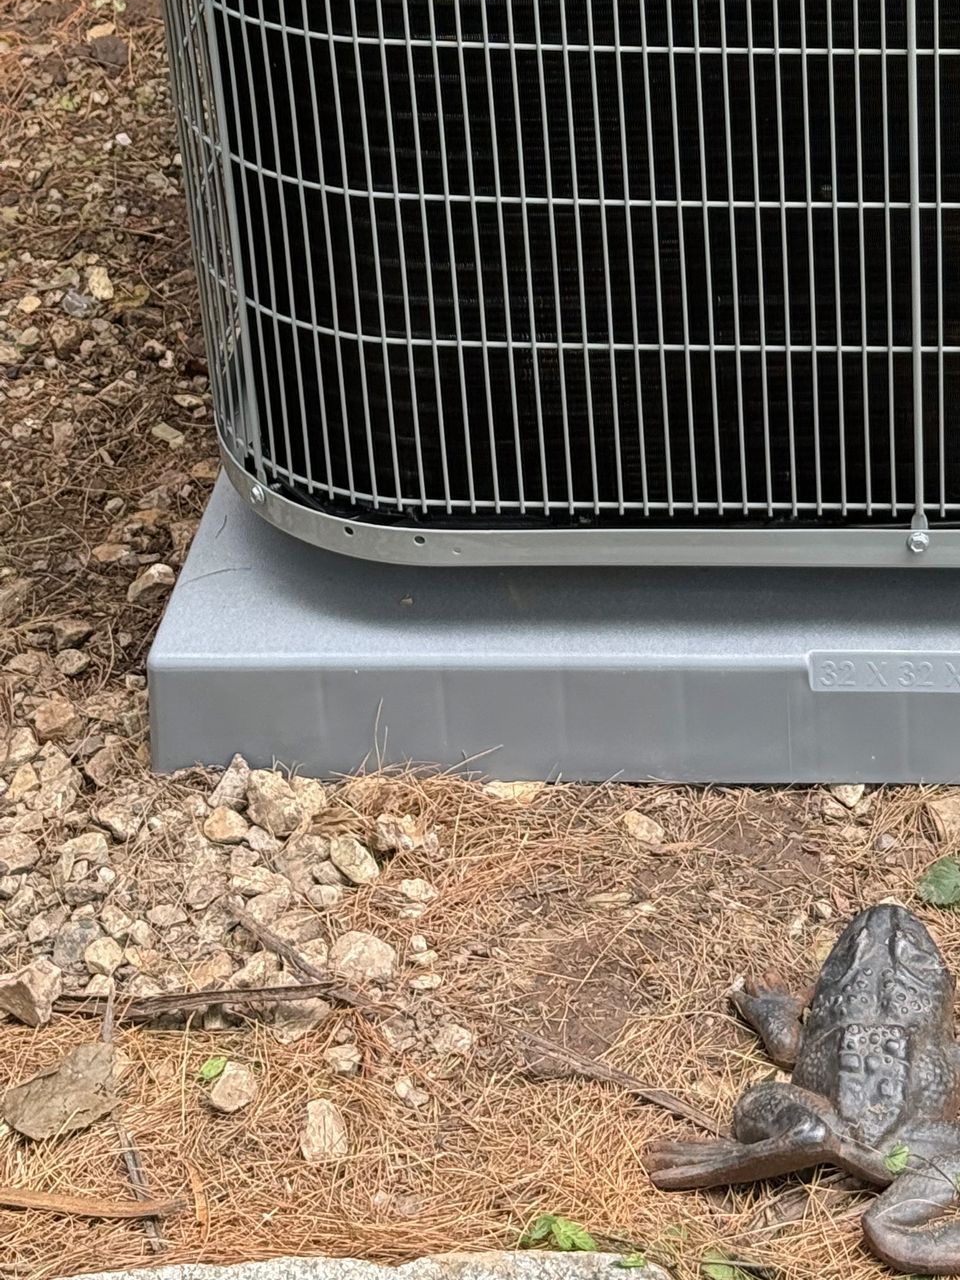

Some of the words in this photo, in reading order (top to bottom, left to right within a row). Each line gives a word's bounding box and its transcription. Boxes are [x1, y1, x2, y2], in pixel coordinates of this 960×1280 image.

[818, 660, 856, 687] 32
[866, 661, 889, 688] X
[898, 661, 935, 688] 32
